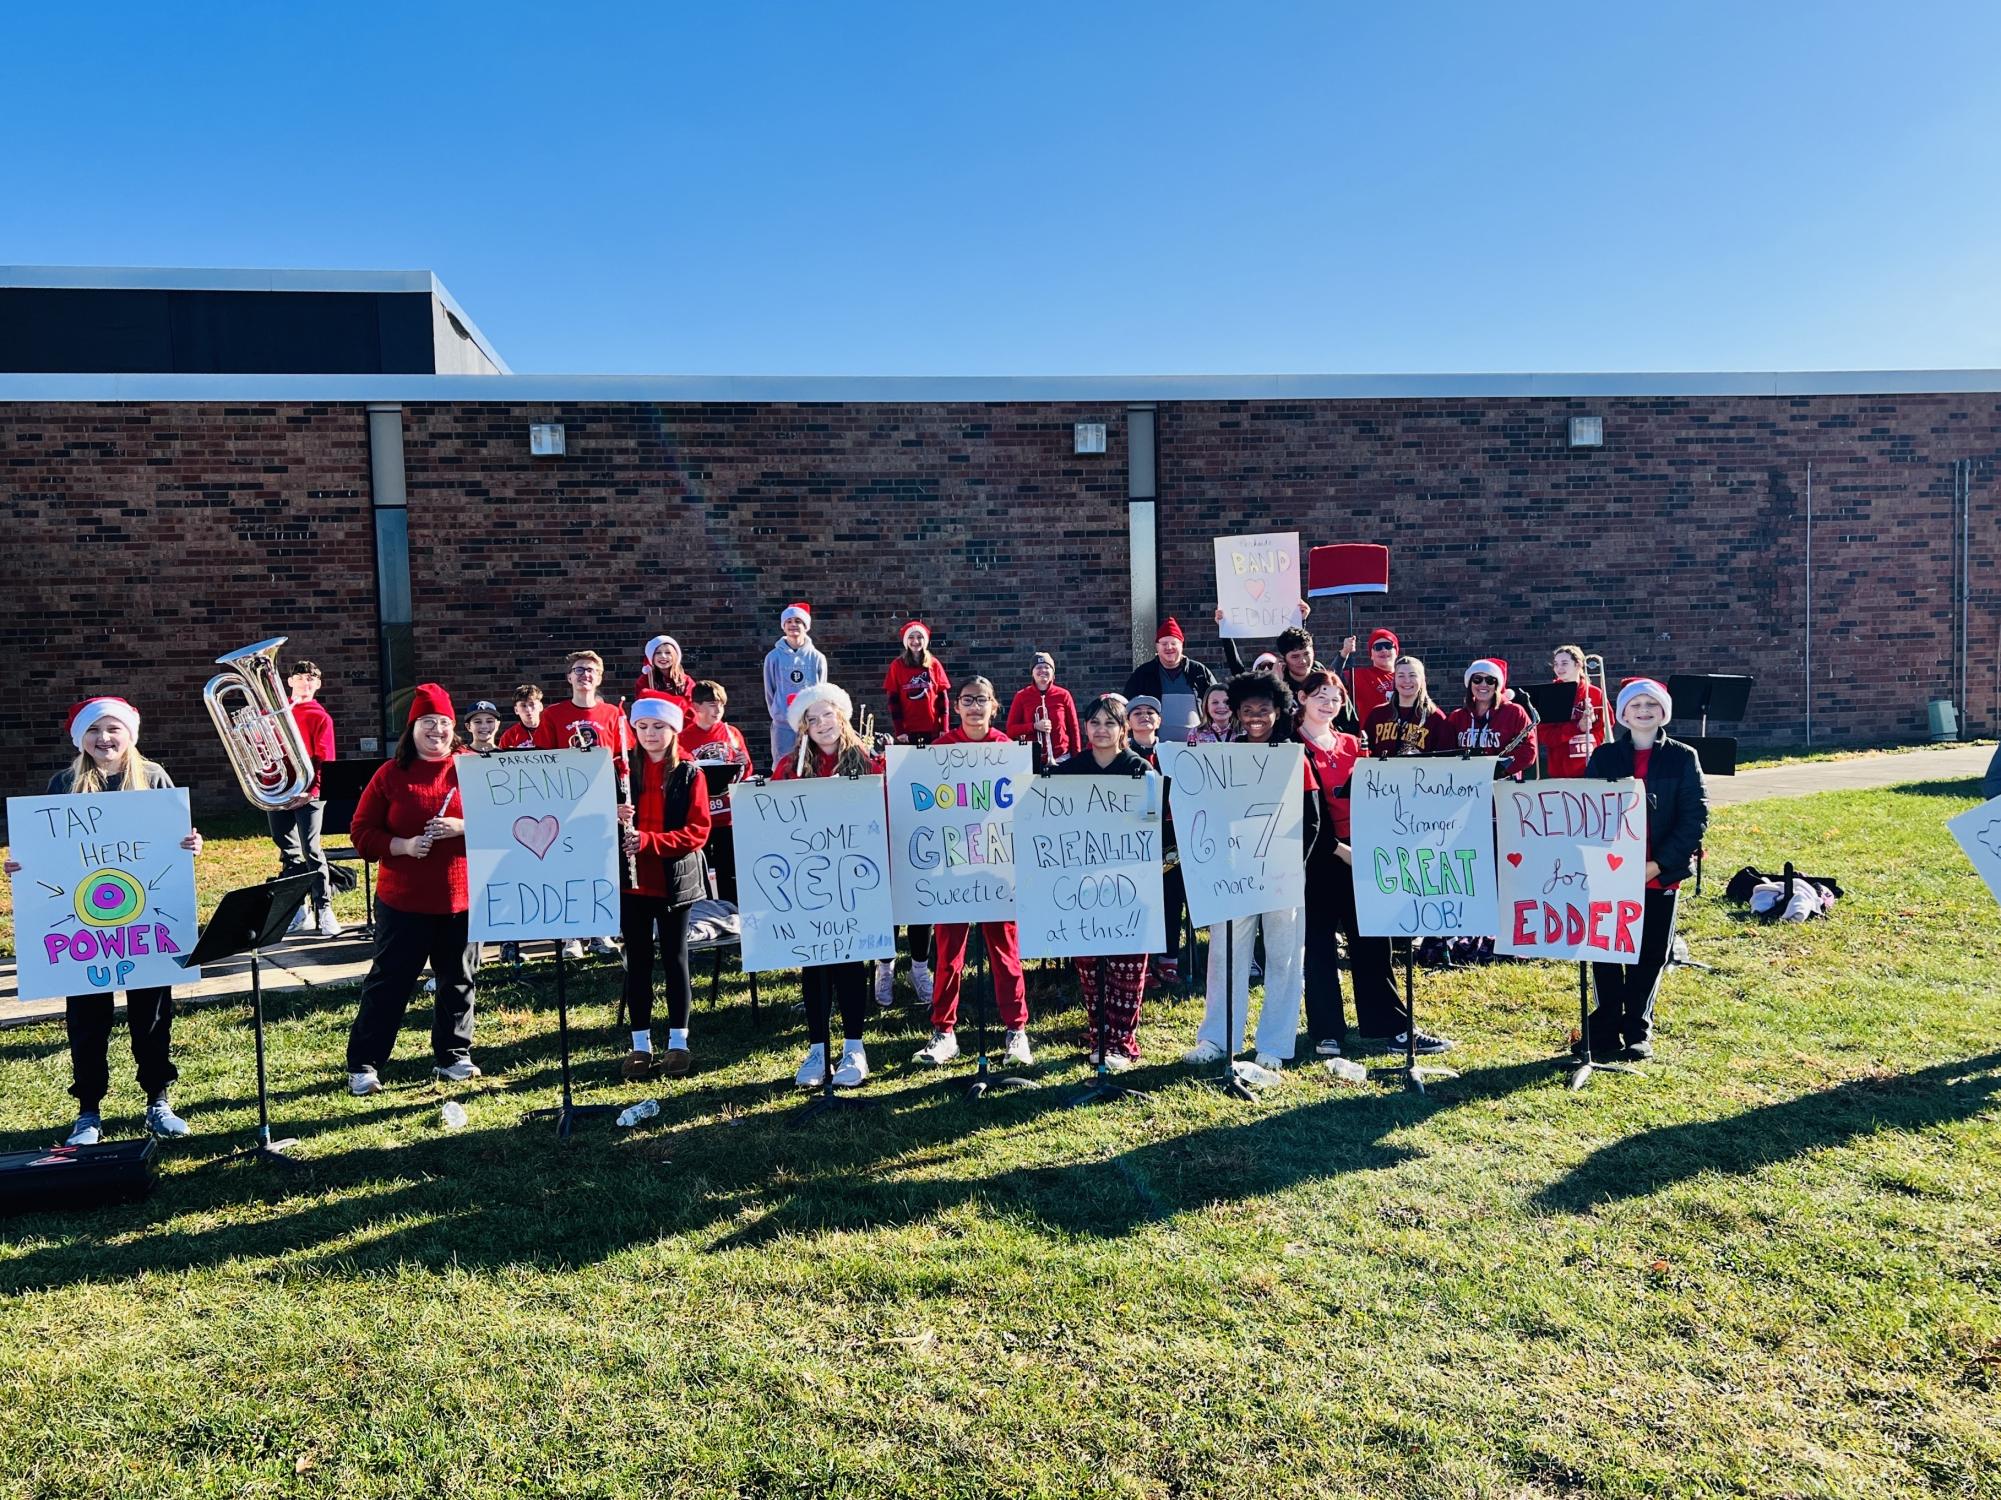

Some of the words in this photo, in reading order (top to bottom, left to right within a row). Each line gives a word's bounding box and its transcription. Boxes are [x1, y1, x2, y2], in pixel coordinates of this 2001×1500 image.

[1231, 549, 1291, 576] BAND
[498, 753, 561, 769] PARKSIDE
[1174, 749, 1270, 796] ONLY
[485, 766, 589, 806] BAND
[910, 776, 1014, 812] DOING
[1086, 783, 1140, 814] ARE
[1412, 767, 1480, 799] Random
[34, 806, 103, 838] TAP
[753, 793, 808, 824] PUT
[1511, 790, 1641, 842] REDDER
[790, 823, 861, 855] SOME
[1243, 802, 1285, 859] 7
[79, 839, 152, 868] HERE
[1032, 829, 1154, 869] REALLY
[752, 853, 880, 913] PEP
[1213, 861, 1265, 897] more!
[1373, 846, 1477, 897] GREAT
[1542, 857, 1590, 895] for
[486, 878, 614, 928] EDDER
[1052, 873, 1137, 911] GOOD
[770, 922, 796, 941] IN
[810, 917, 861, 938] YOUR
[1046, 919, 1069, 943] at
[1078, 908, 1141, 943] this!!
[1399, 898, 1463, 934] JOB!
[1512, 899, 1643, 954] EDDER
[43, 921, 180, 965] POWER
[791, 936, 853, 963] STEP!
[86, 960, 136, 987] UP
